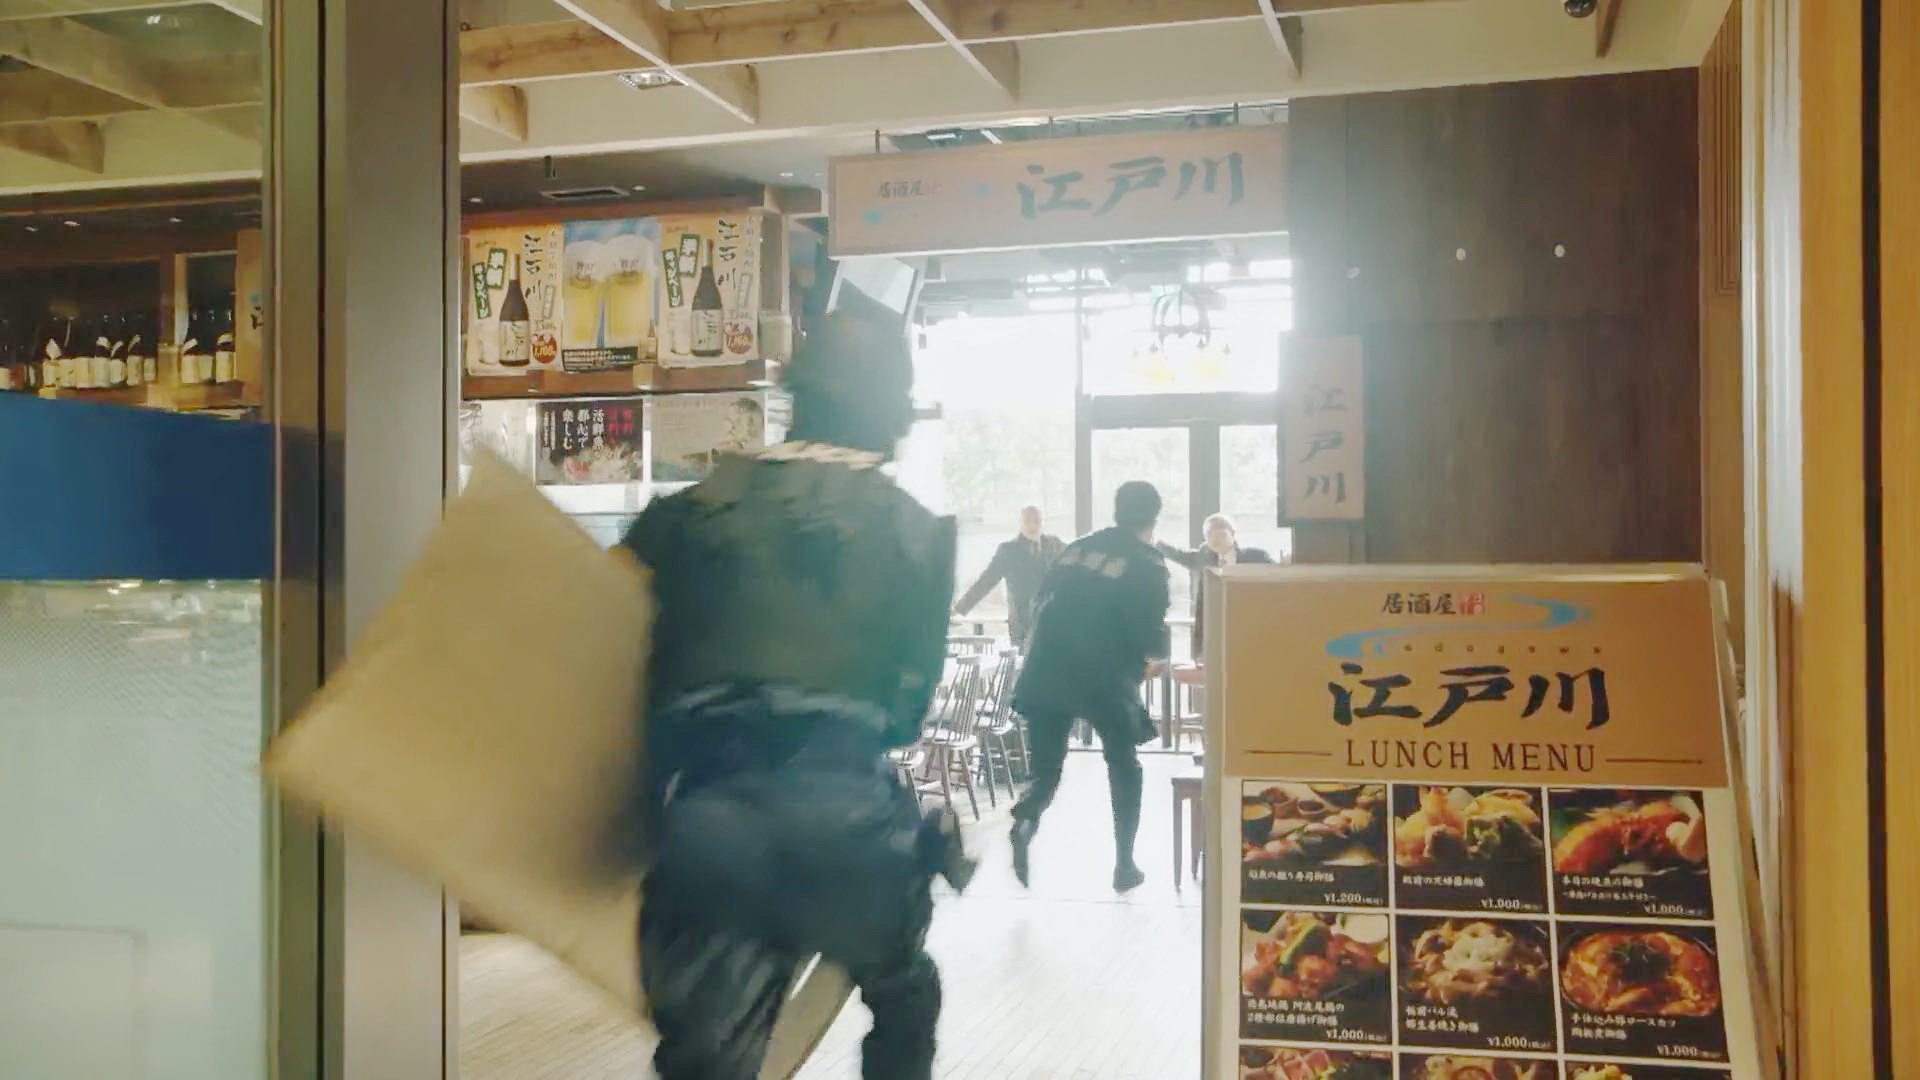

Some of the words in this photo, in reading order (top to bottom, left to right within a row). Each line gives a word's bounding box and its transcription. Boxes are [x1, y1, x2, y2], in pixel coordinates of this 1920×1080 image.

[1015, 152, 1244, 221] 江戸川
[1299, 384, 1347, 504] 江戸川
[1382, 592, 1456, 615] 居酒屋
[1327, 662, 1610, 730] 江戸川
[1345, 739, 1470, 770] LUNCH
[1492, 742, 1597, 773] MENU
